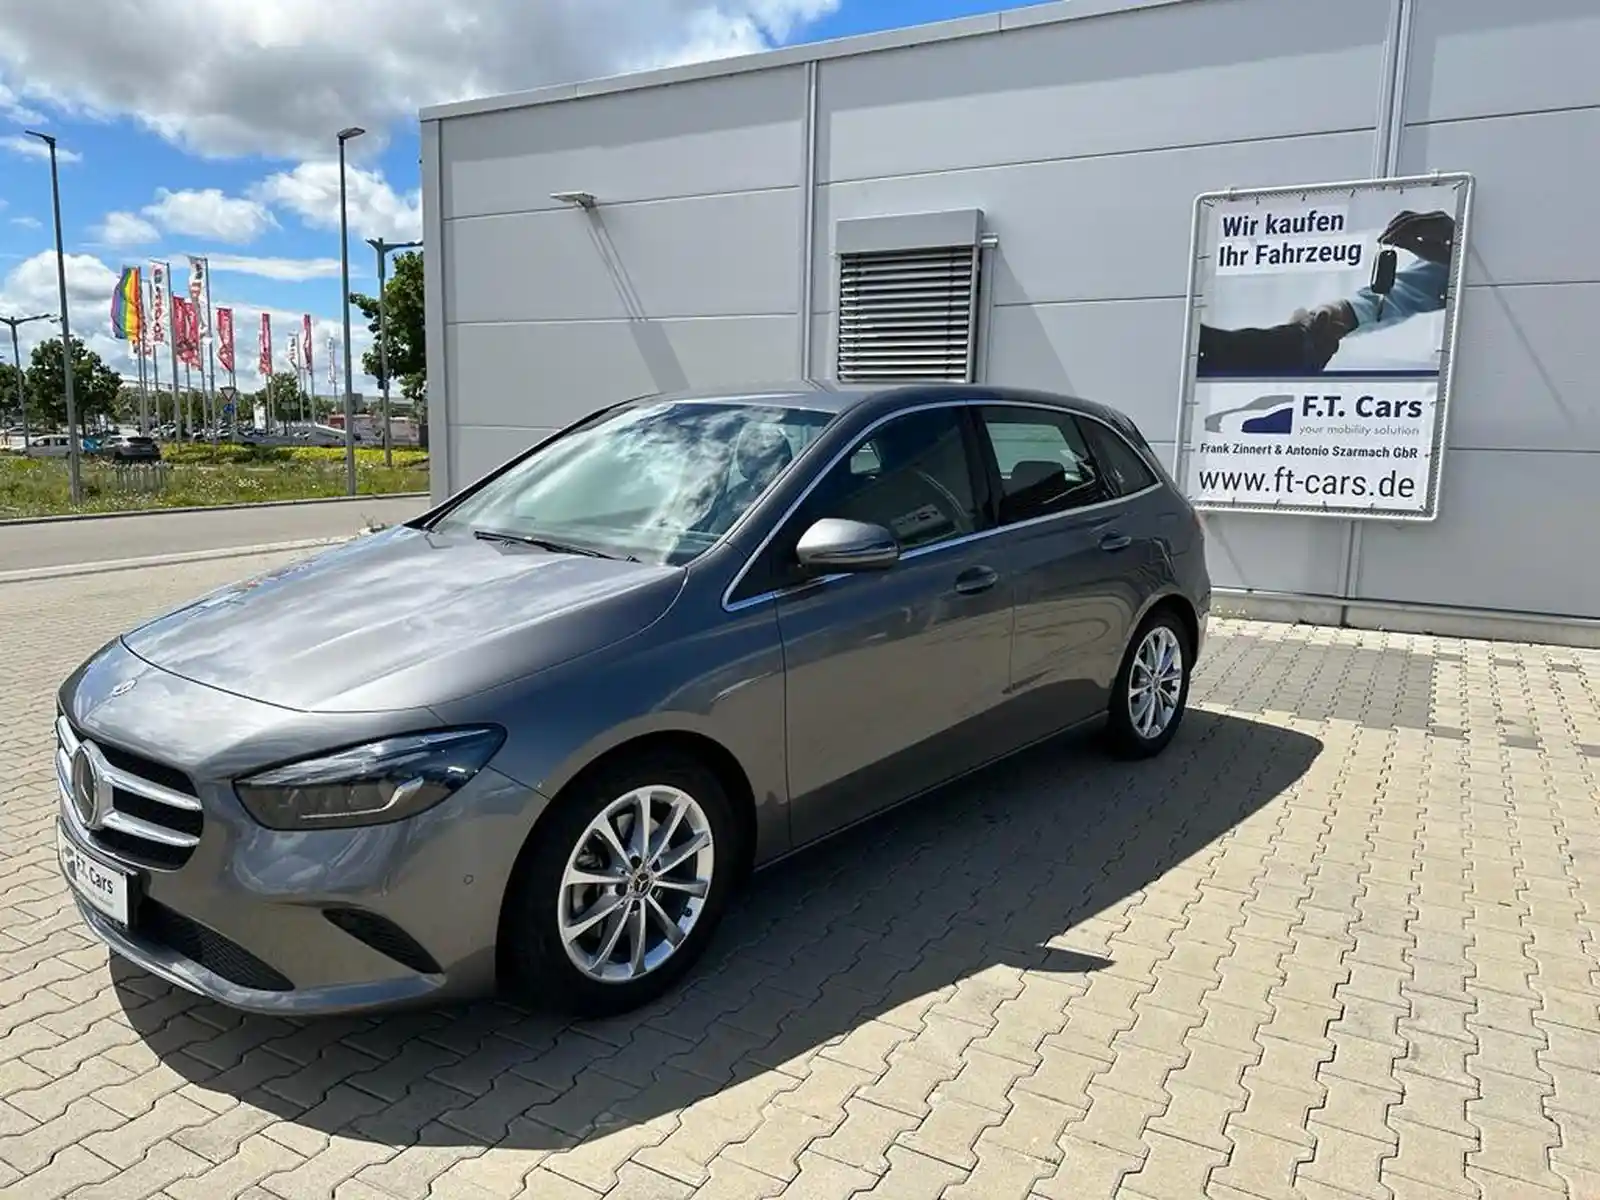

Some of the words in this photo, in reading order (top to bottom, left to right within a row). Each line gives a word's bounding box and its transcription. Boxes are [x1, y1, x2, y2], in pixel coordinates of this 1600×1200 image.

[1223, 216, 1258, 237] Wir
[1265, 211, 1344, 236] kaufen
[1219, 246, 1248, 267] Ihr
[1255, 242, 1362, 265] Fahrzeug
[1302, 396, 1345, 418] F.T.
[1356, 396, 1422, 418] Cars
[1299, 426, 1323, 435] your
[1327, 425, 1371, 435] mobility
[1374, 425, 1419, 435] solution
[1200, 444, 1229, 455] Frank
[1232, 445, 1271, 455] Zinnert
[1275, 445, 1283, 455] &
[1285, 446, 1328, 457] Antonio
[1332, 446, 1390, 458] Szarmach
[1393, 447, 1417, 458] GbR
[1199, 467, 1415, 498] www.ft-cars.de
[89, 866, 114, 894] Cars
